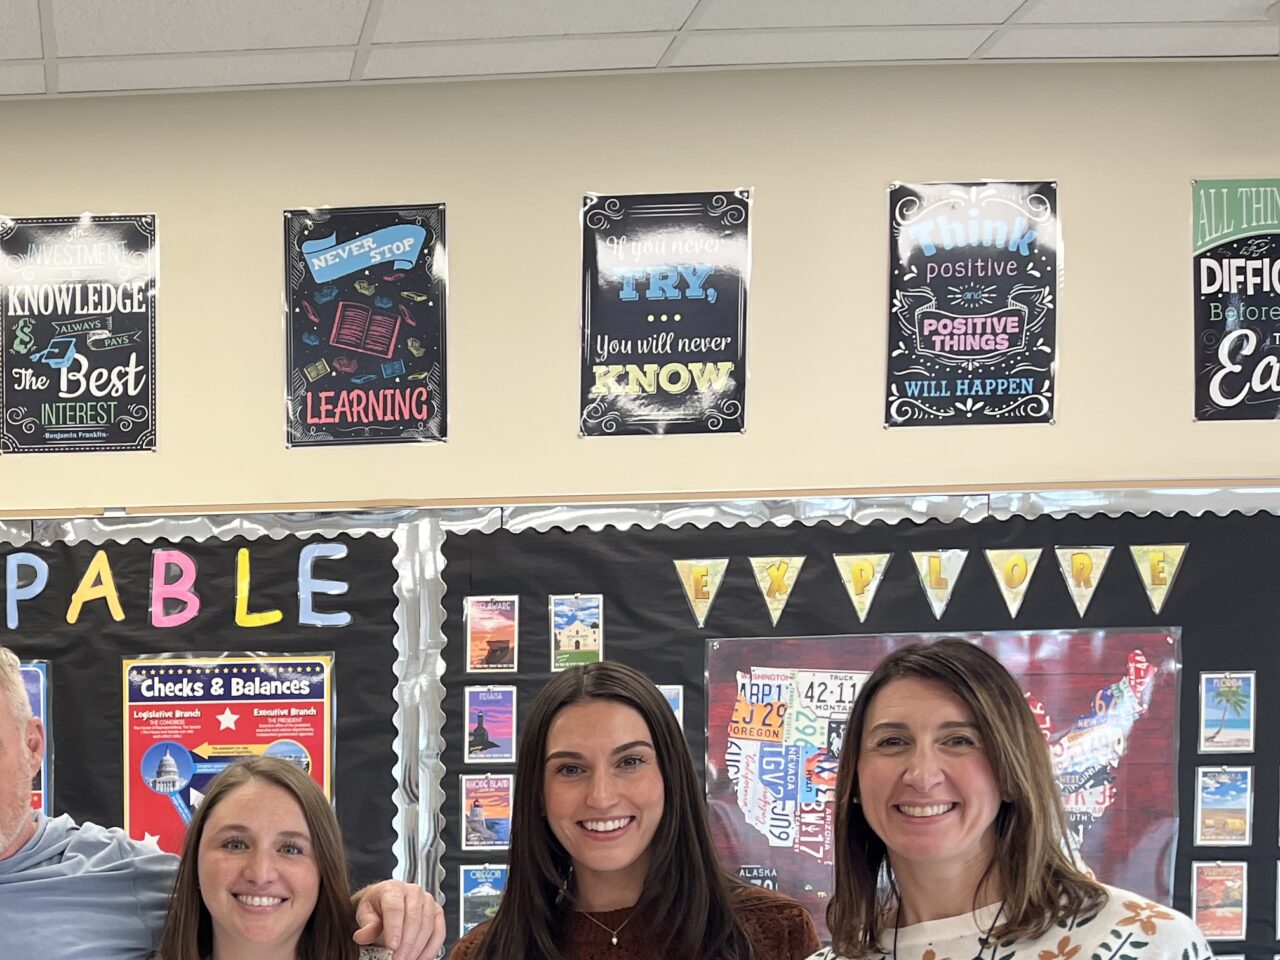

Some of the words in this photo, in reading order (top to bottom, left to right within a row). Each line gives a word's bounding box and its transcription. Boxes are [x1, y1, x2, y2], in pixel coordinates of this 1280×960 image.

[1197, 189, 1234, 246] ALL
[908, 208, 1037, 256] Think
[312, 238, 376, 270] NEVER
[372, 238, 414, 262] STOP
[632, 240, 667, 262] you
[613, 264, 717, 303] TRY,
[8, 282, 146, 316] KNOWLEDGE
[963, 290, 982, 300] and
[60, 320, 101, 334] ALWAYS
[924, 317, 1019, 335] POSITIVE
[105, 336, 129, 347] PAYS
[596, 334, 632, 361] You
[638, 332, 673, 354] will
[678, 337, 731, 352] never
[932, 334, 1009, 351] THINGS
[12, 369, 49, 390] The
[59, 352, 146, 398] Best
[592, 362, 734, 396] KNOW
[905, 380, 950, 397] WILL
[956, 378, 1034, 396] HAPPEN
[42, 402, 117, 424] INTEREST
[307, 387, 428, 424] LEARNING
[141, 677, 203, 697] Checks
[210, 678, 224, 695] &
[231, 677, 310, 696] Balances
[134, 710, 173, 720] Legislative
[175, 708, 200, 717] Branch
[254, 708, 288, 716] Executive
[291, 707, 317, 716] Branch
[734, 725, 779, 738] OREGON
[787, 747, 796, 790] NEVADA
[740, 868, 777, 877] ALASKA
